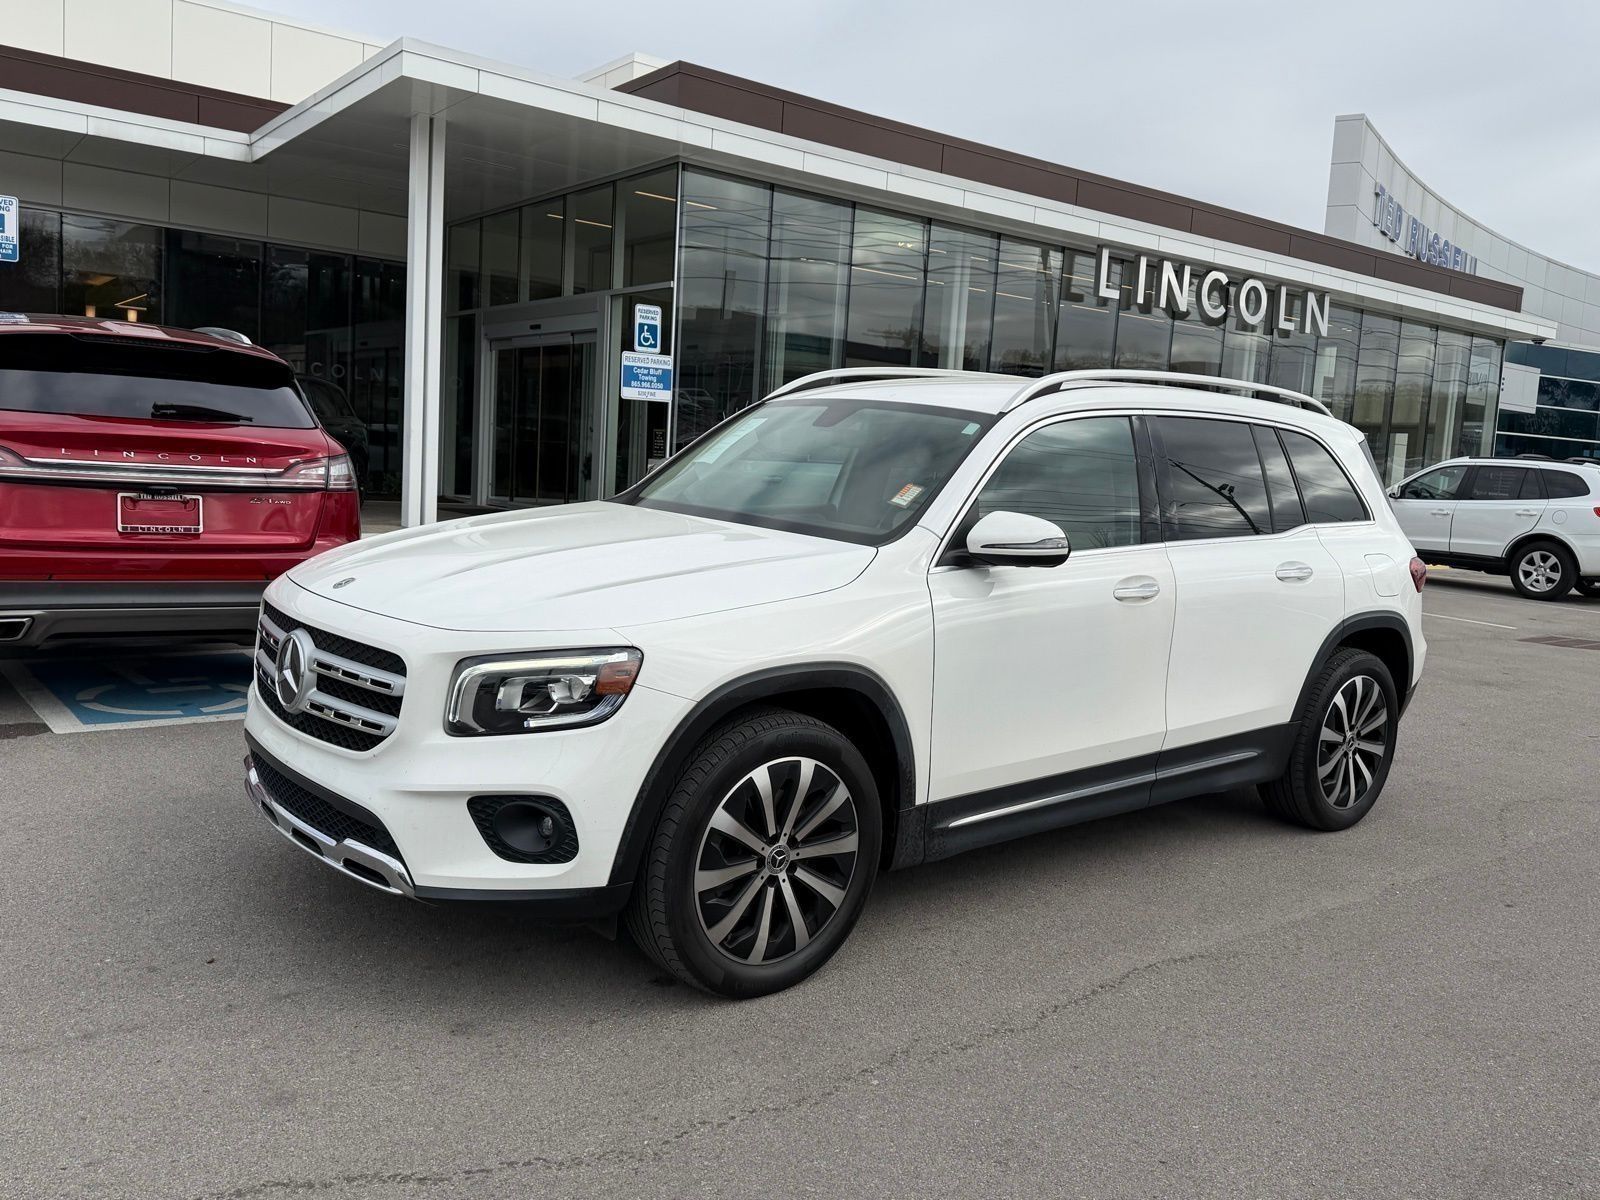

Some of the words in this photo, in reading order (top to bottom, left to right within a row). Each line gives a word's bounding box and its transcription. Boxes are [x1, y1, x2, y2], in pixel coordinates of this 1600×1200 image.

[1374, 183, 1403, 242] TED
[1096, 246, 1330, 337] LINCOLN
[624, 356, 649, 364] RESERVED
[650, 358, 671, 366] PARKING
[639, 374, 657, 382] Towing
[61, 447, 257, 464] LINCOLN
